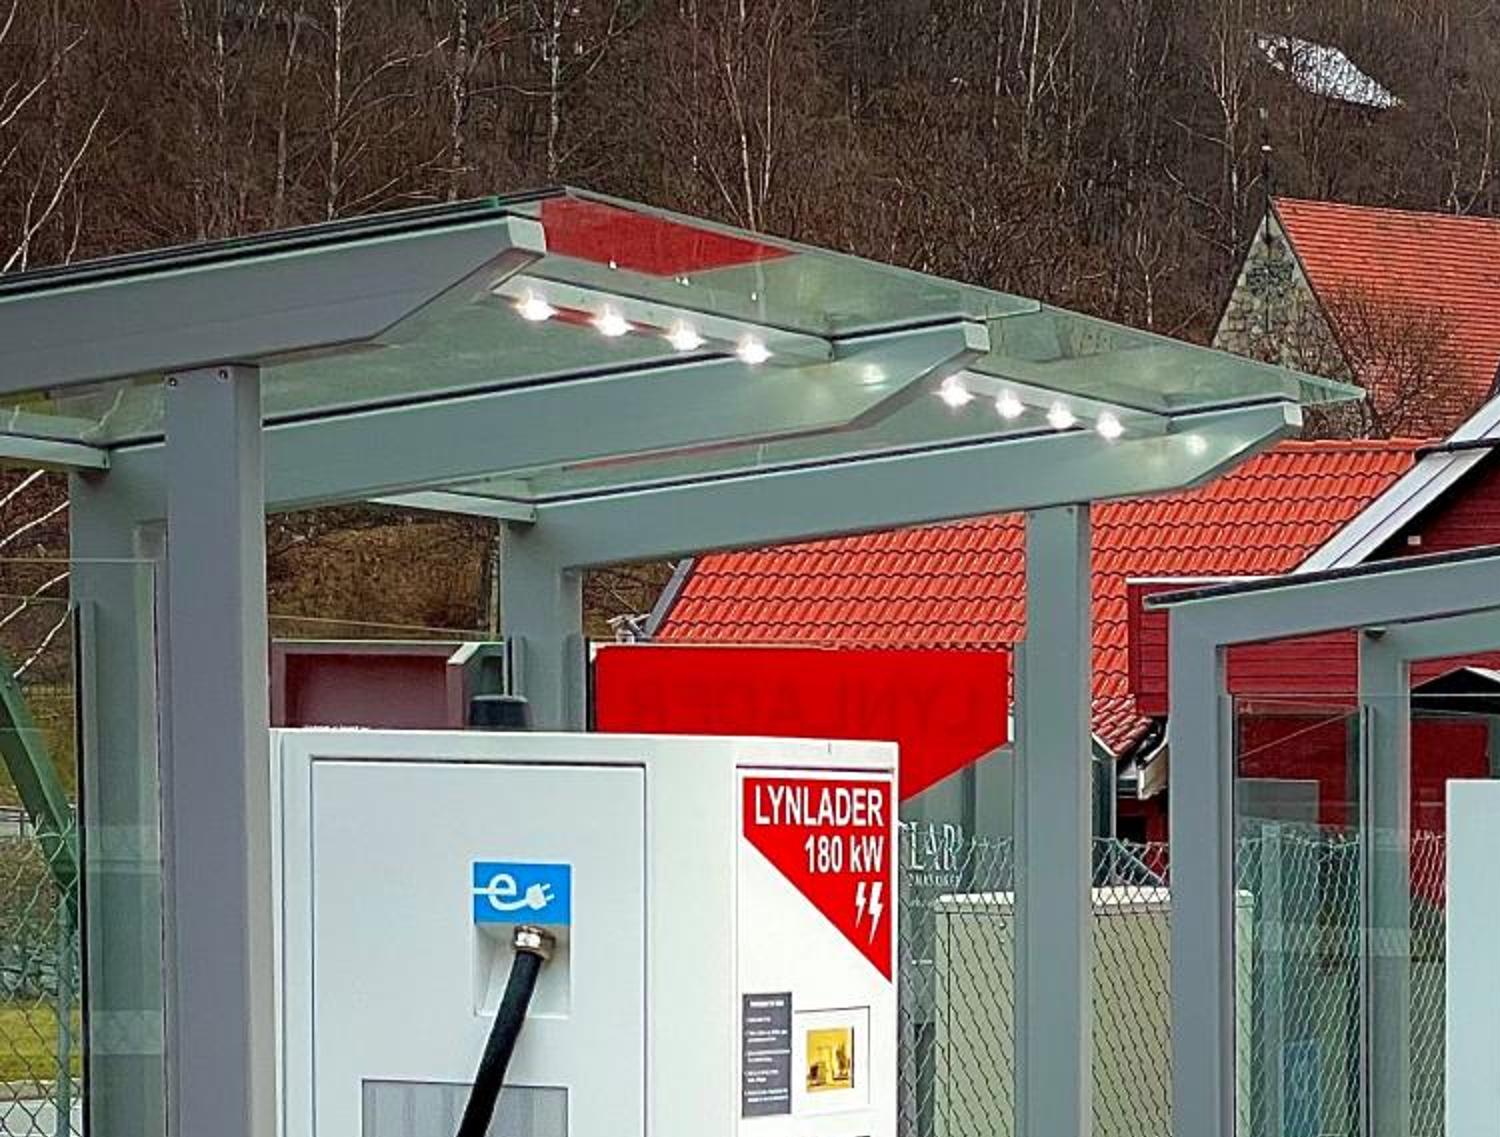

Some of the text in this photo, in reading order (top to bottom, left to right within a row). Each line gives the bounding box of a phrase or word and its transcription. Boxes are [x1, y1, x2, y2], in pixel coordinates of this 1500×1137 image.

[755, 785, 885, 827] LYNLADER
[804, 834, 885, 874] 180 kW
